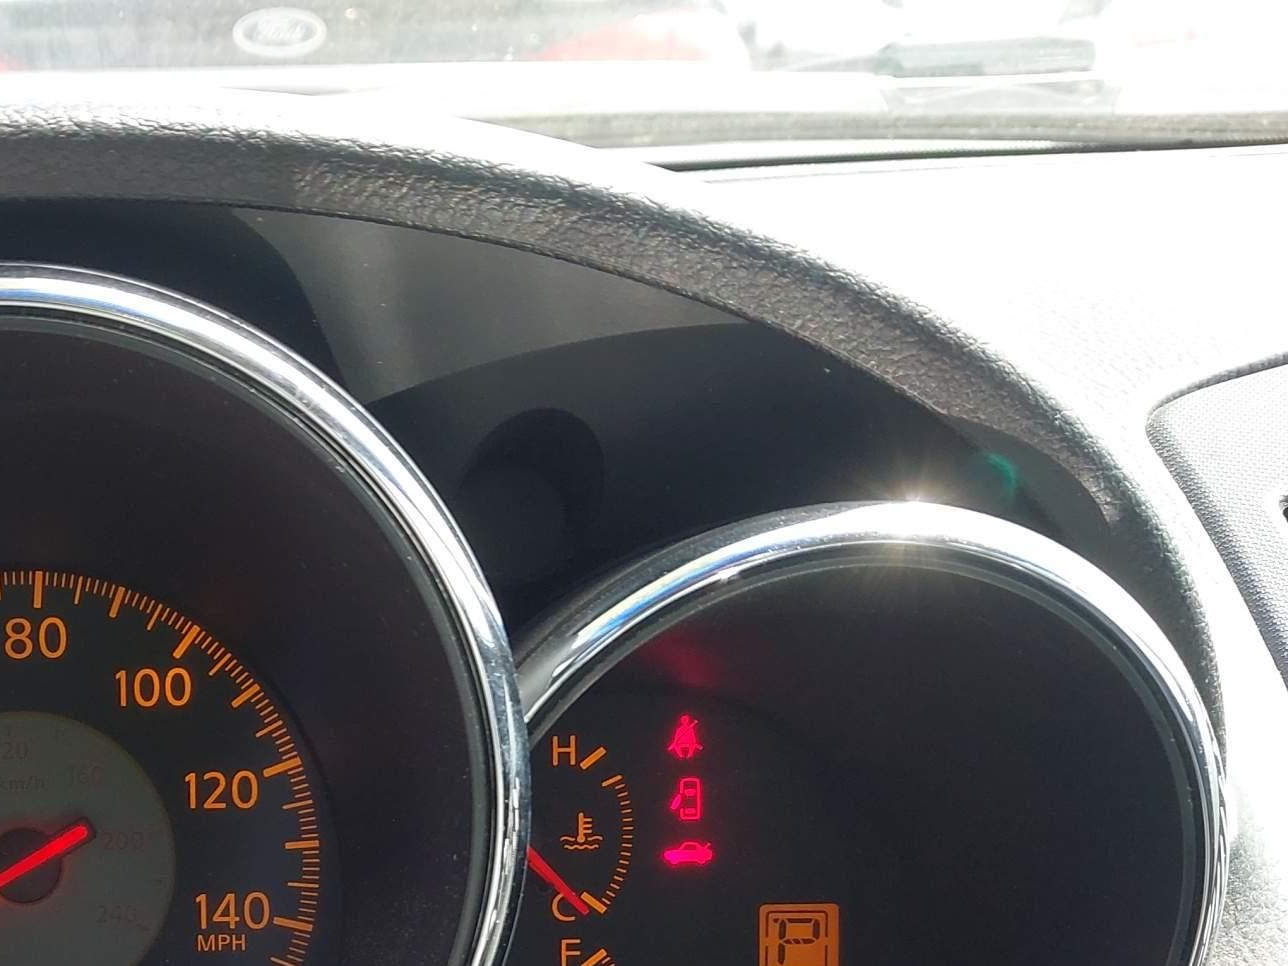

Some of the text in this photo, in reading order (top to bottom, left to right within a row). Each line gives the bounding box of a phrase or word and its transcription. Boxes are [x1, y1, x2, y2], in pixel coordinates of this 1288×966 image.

[4, 616, 67, 660] 80
[115, 667, 192, 707] 100
[552, 735, 576, 766] H
[184, 770, 258, 809] 120
[195, 891, 270, 930] 140
[551, 892, 577, 922] C
[197, 934, 246, 951] MPH
[773, 917, 821, 965] P
